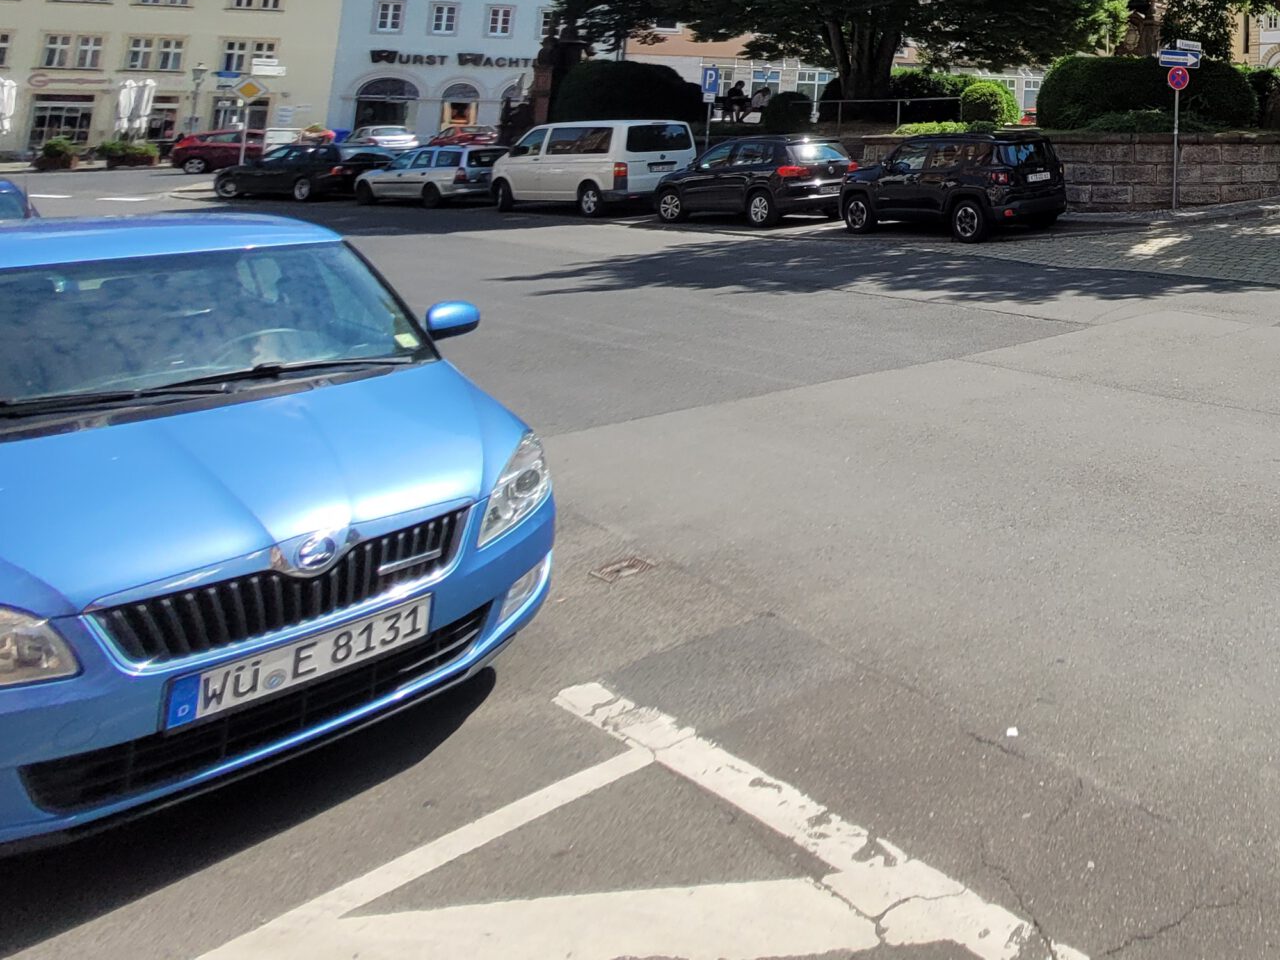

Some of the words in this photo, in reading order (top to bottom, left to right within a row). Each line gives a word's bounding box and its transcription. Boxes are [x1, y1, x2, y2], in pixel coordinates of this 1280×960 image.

[370, 50, 448, 66] WURST
[706, 70, 716, 89] P
[203, 660, 262, 710] WÜ
[292, 642, 317, 680] E
[331, 605, 422, 664] 8131
[177, 704, 189, 717] D
